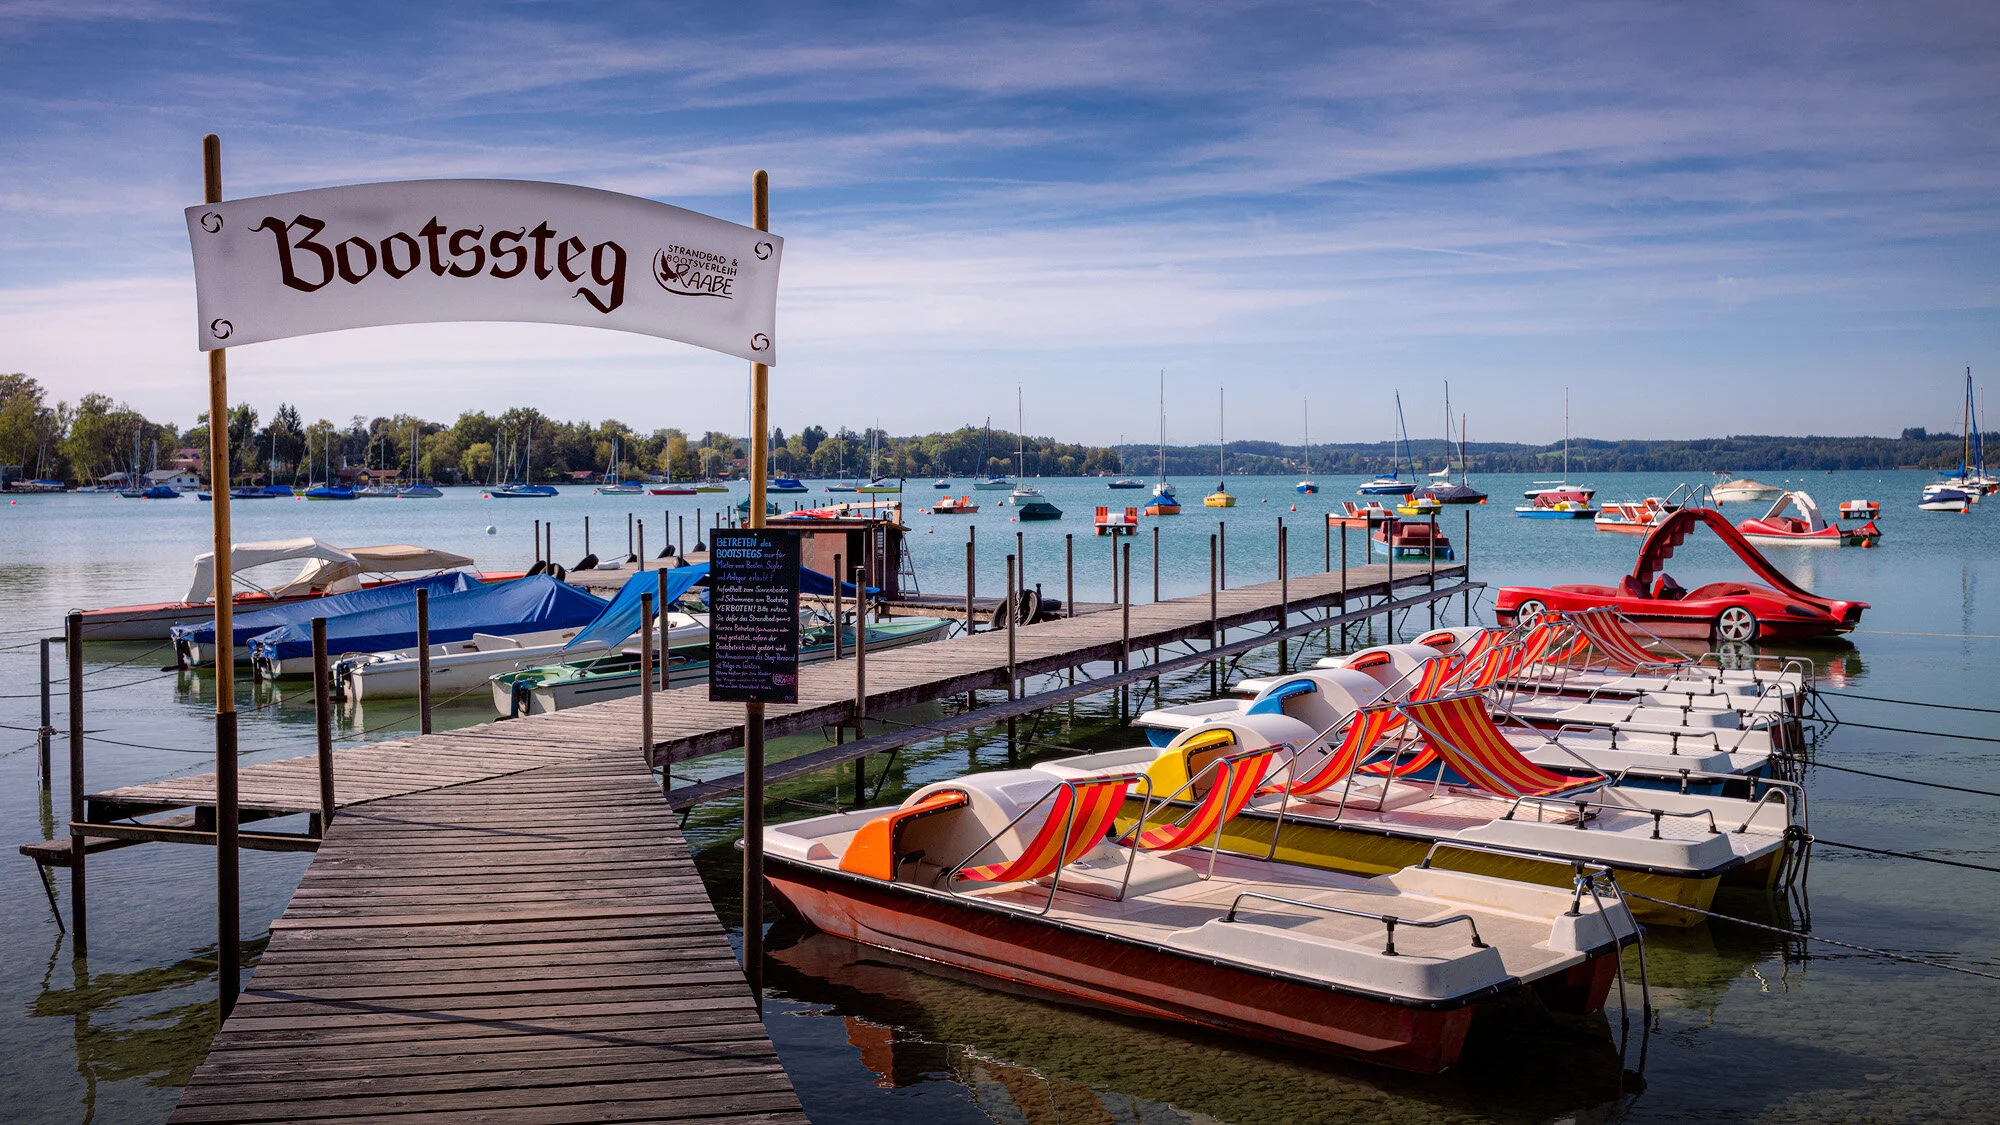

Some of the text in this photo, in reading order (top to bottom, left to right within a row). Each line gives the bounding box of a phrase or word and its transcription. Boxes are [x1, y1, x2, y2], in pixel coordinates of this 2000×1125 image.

[248, 213, 627, 314] Bootssteg
[666, 254, 737, 276] BOOTSVERLEIH
[668, 244, 738, 267] STRANDBAD &
[676, 263, 734, 295] RAABE
[716, 538, 757, 547] BETRETEN
[716, 549, 762, 558] BOOTSTEGS
[715, 604, 757, 612] VERBOTEN!
